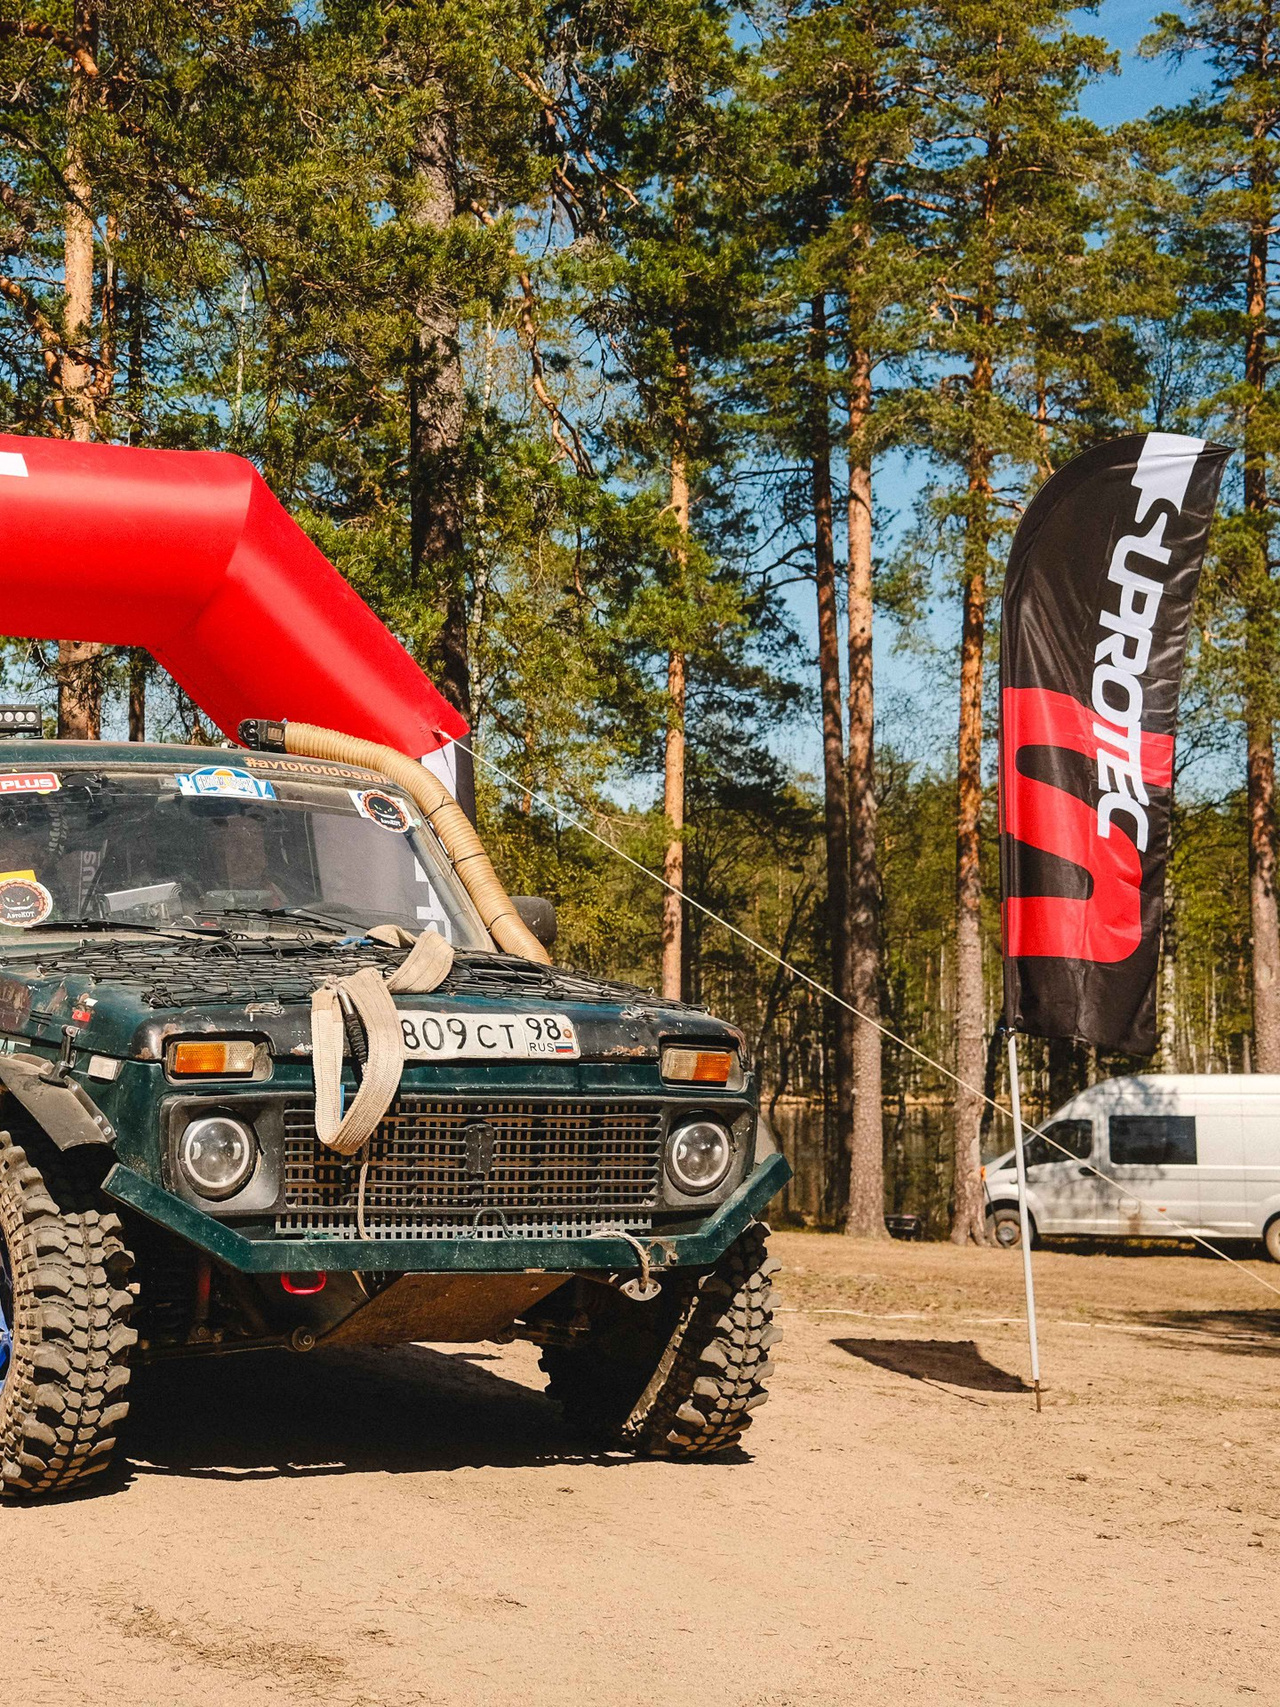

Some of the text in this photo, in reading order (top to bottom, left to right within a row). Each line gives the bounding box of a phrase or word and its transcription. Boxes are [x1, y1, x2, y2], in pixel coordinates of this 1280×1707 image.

[1092, 488, 1181, 852] SUPROTEC
[525, 1017, 562, 1040] 98
[529, 1042, 555, 1053] RUS
